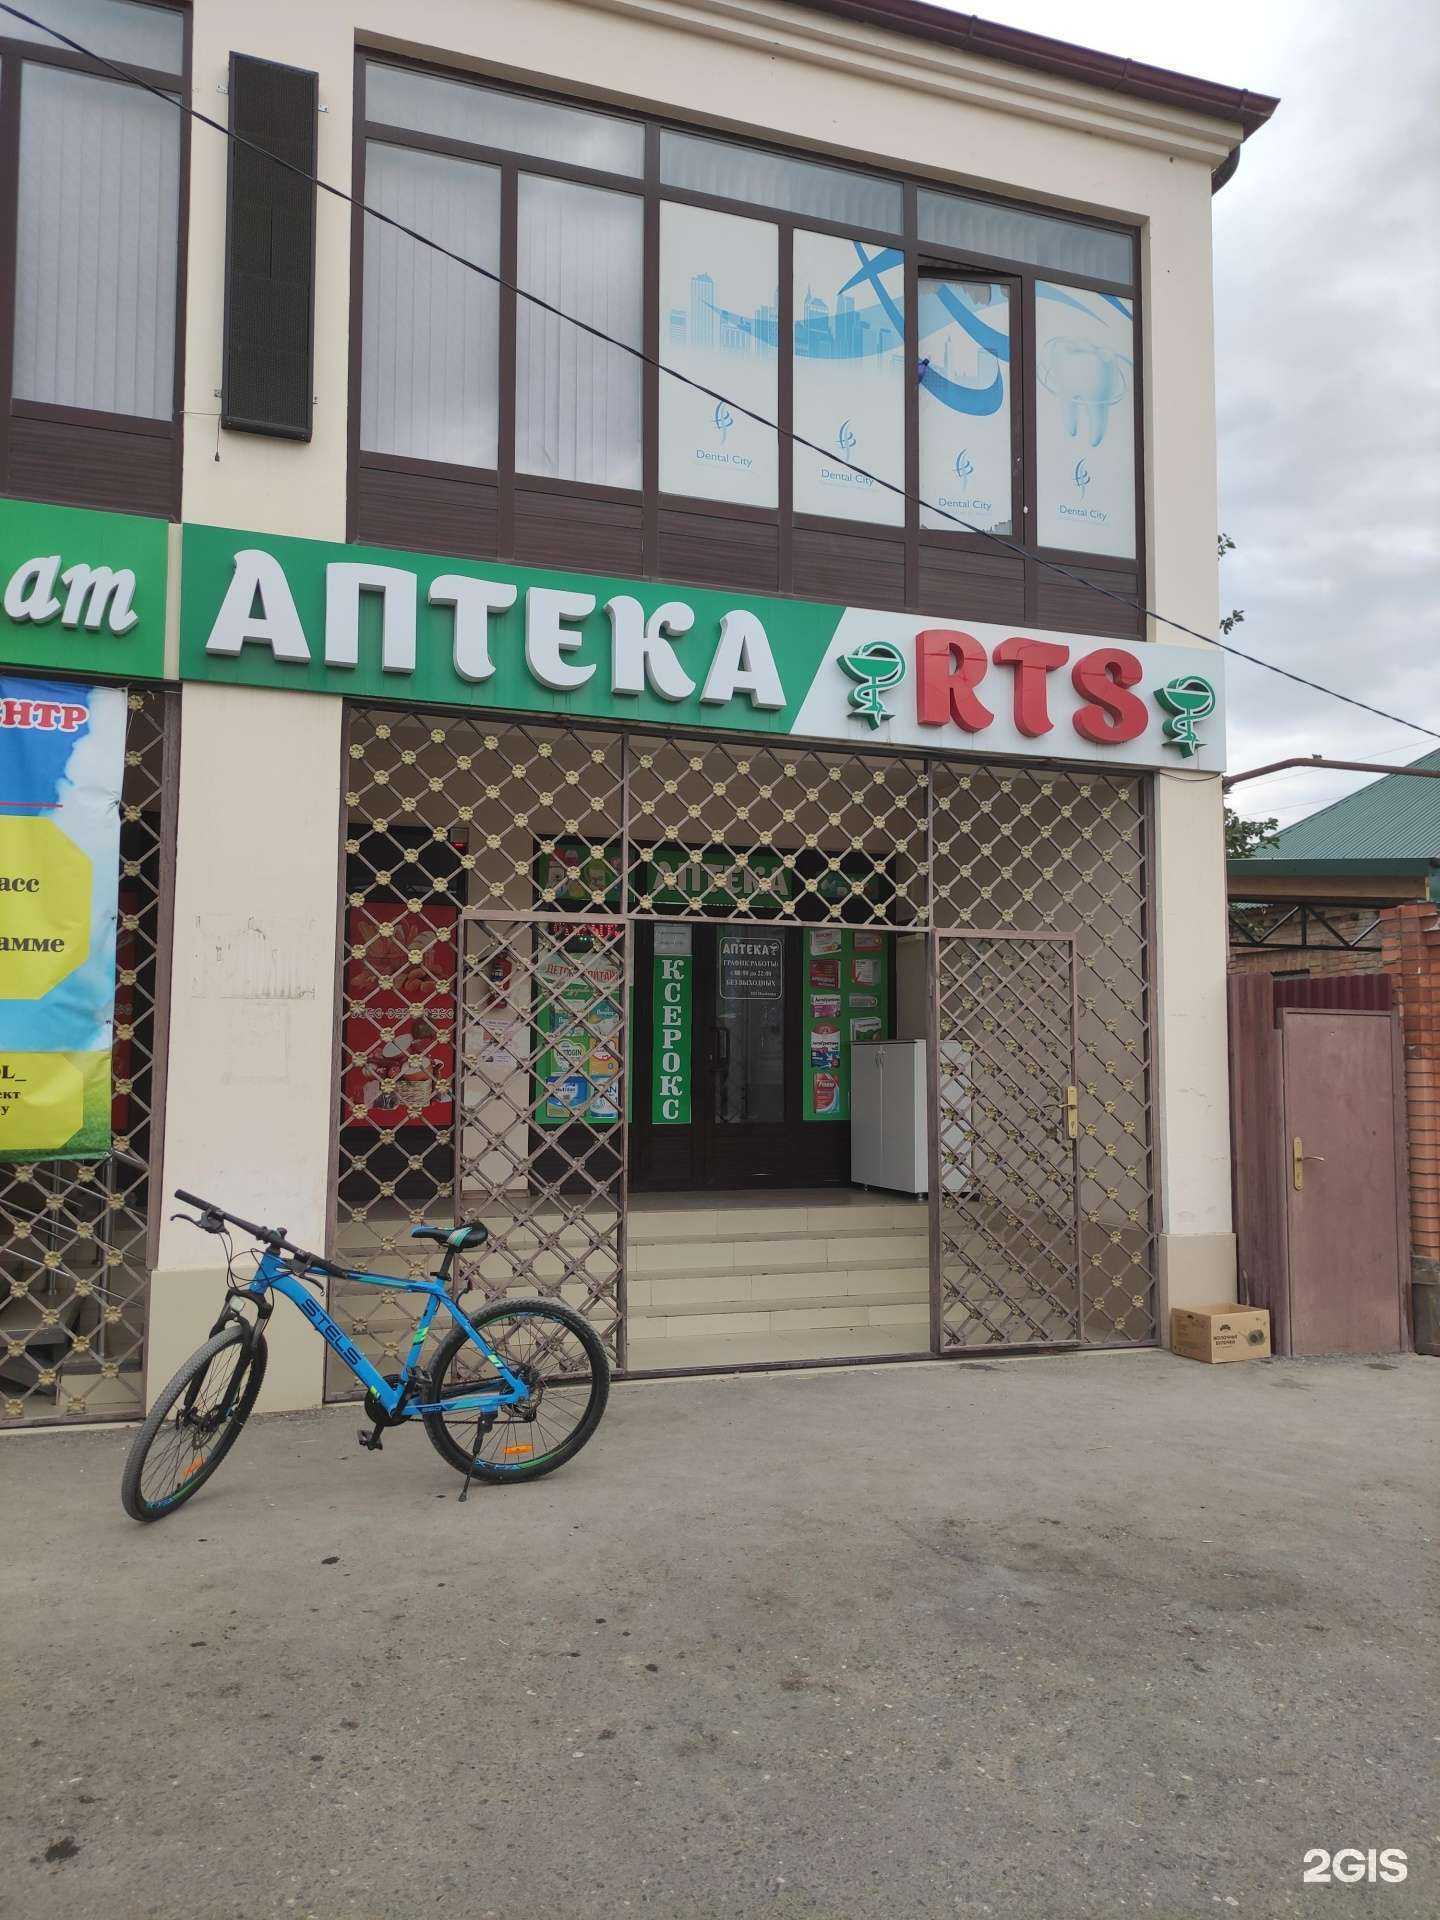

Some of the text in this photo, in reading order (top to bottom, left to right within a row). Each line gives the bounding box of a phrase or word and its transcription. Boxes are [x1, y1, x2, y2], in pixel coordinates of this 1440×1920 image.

[696, 449, 753, 468] Dental City
[821, 468, 874, 487] Dental City
[938, 497, 992, 512] Dental City
[1059, 504, 1108, 521] Dental City
[205, 549, 787, 709] АПТЕКА
[916, 629, 1149, 745] RTS
[0, 698, 89, 732] НТР
[653, 861, 789, 896] АПТЕКА
[722, 943, 769, 956] АПТЕКА
[660, 959, 685, 1120] КСЕРОКС
[0, 1065, 27, 1082] L_
[302, 1298, 362, 1366] STELS
